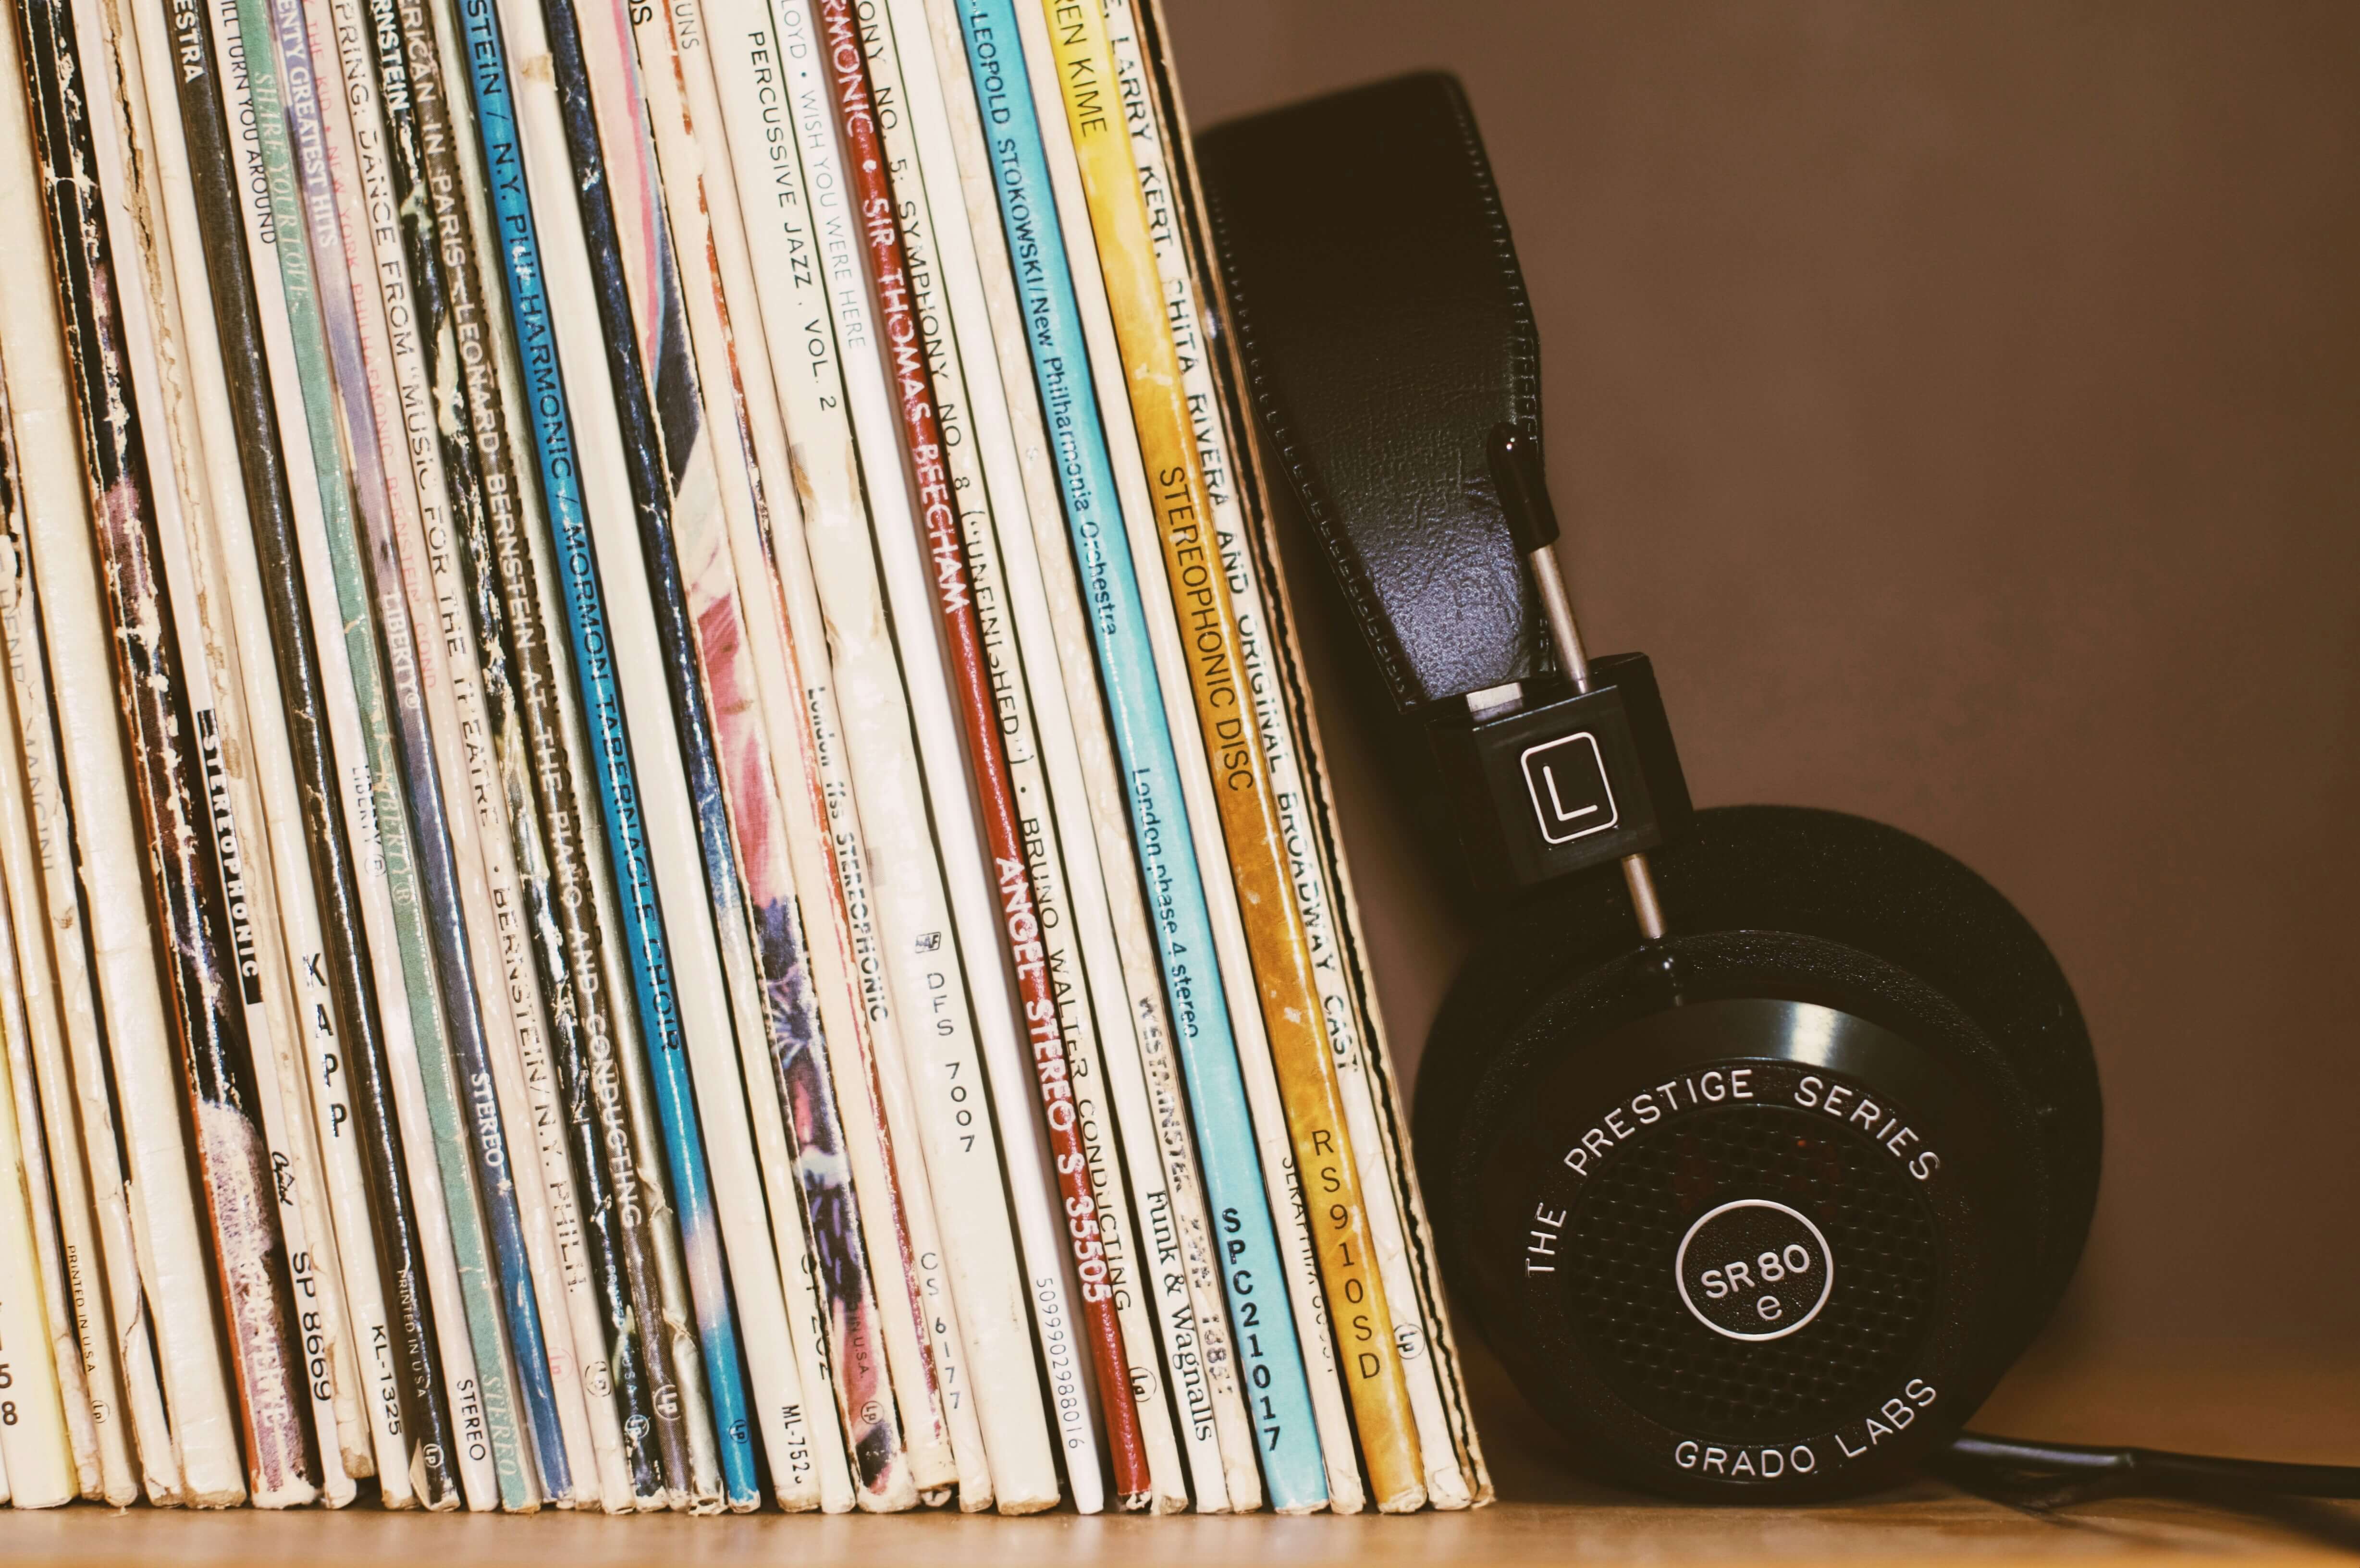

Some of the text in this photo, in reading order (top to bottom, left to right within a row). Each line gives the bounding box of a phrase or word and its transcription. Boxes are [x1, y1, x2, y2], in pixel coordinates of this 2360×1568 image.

[225, 34, 250, 91] TURN
[1067, 58, 1107, 137] KIME
[236, 98, 259, 143] YOU
[287, 65, 329, 187] GREATEST
[311, 193, 340, 249] HITS
[422, 122, 445, 155] IN
[491, 142, 521, 201] N.Y.
[798, 90, 826, 149] WISH
[245, 148, 277, 246] AROUND
[251, 70, 311, 301] SHARE YOUR LOVE
[337, 208, 360, 270] YORK
[746, 31, 837, 412] PERCUSSIVE JAZZ VOL. 2
[811, 157, 838, 208] YOU
[861, 196, 896, 249] SIR
[824, 216, 852, 281] WERE
[505, 214, 572, 480] PHILHARMONIC
[838, 289, 866, 349] HERE
[876, 268, 932, 426] THOMAS
[970, 12, 1010, 125] LEOPOLD
[1042, 356, 1093, 512] Philharmonia
[1078, 521, 1119, 637] Orchestra
[484, 472, 537, 650] BERNSTEIN
[911, 442, 971, 615] BEECHAM
[1110, 36, 1152, 146] LARRY
[1187, 392, 1230, 508] RIVERA
[1217, 527, 1250, 596] AND
[1236, 612, 1291, 774] ORIGINAL
[1276, 790, 1336, 977] BROADWAY
[1321, 992, 1359, 1076] CAST
[562, 524, 609, 682] MORMON
[1157, 465, 1254, 793] STEREOPHONIC DISC
[357, 129, 395, 246] DANCE
[380, 260, 416, 356] FROM
[423, 505, 452, 576] FOR
[439, 595, 467, 658] THE
[549, 1180, 588, 1294] PHILH.
[520, 668, 548, 711] AT
[873, 86, 901, 141] NO.
[897, 200, 950, 383] SYMPHONY
[937, 403, 964, 457] NO.
[952, 476, 971, 491] 8
[1021, 817, 1060, 931] BRUNO
[1047, 949, 1089, 1080] WALTER
[1075, 1098, 1134, 1311] CONDUCTING
[531, 727, 563, 795] THE
[594, 694, 656, 925] TABERNACLE
[1543, 765, 1598, 821] L
[199, 733, 261, 979] STEREOPHONIC
[546, 811, 584, 909] PIANO
[806, 686, 840, 767] London
[834, 832, 890, 1024] STEREOPHONIC
[1130, 768, 1203, 1039] London phase 4 stereo
[568, 926, 600, 995] AND
[640, 938, 680, 1053] CHOIR
[301, 952, 353, 1139] KAPP
[995, 853, 1112, 1305] ANGEL STEREO S 35505
[1137, 993, 1193, 1192] WESTMINSTER
[469, 1071, 506, 1169] STEREO
[583, 1012, 643, 1230] CONDUCTING
[945, 1061, 975, 1152] 7007
[1525, 1069, 1942, 1278] THE PRESTIGE SERIES
[67, 1245, 86, 1308] PRINTED
[79, 1313, 88, 1330] IN
[289, 1250, 333, 1404] SP 8669
[393, 1268, 419, 1355] PRINTED IN
[1145, 1189, 1216, 1444] Funk & Wagnalls
[1217, 1207, 1288, 1452] SPC21017
[1757, 1295, 1783, 1321] e
[369, 1324, 403, 1437] KL-1325
[851, 1335, 871, 1380] U.S.A.
[935, 1316, 961, 1409] 6177
[1034, 1276, 1085, 1450] 5099902988016
[455, 1378, 487, 1463] STEREO
[480, 1373, 517, 1477] STEREO
[1675, 1378, 1937, 1479] GRADO LABS
